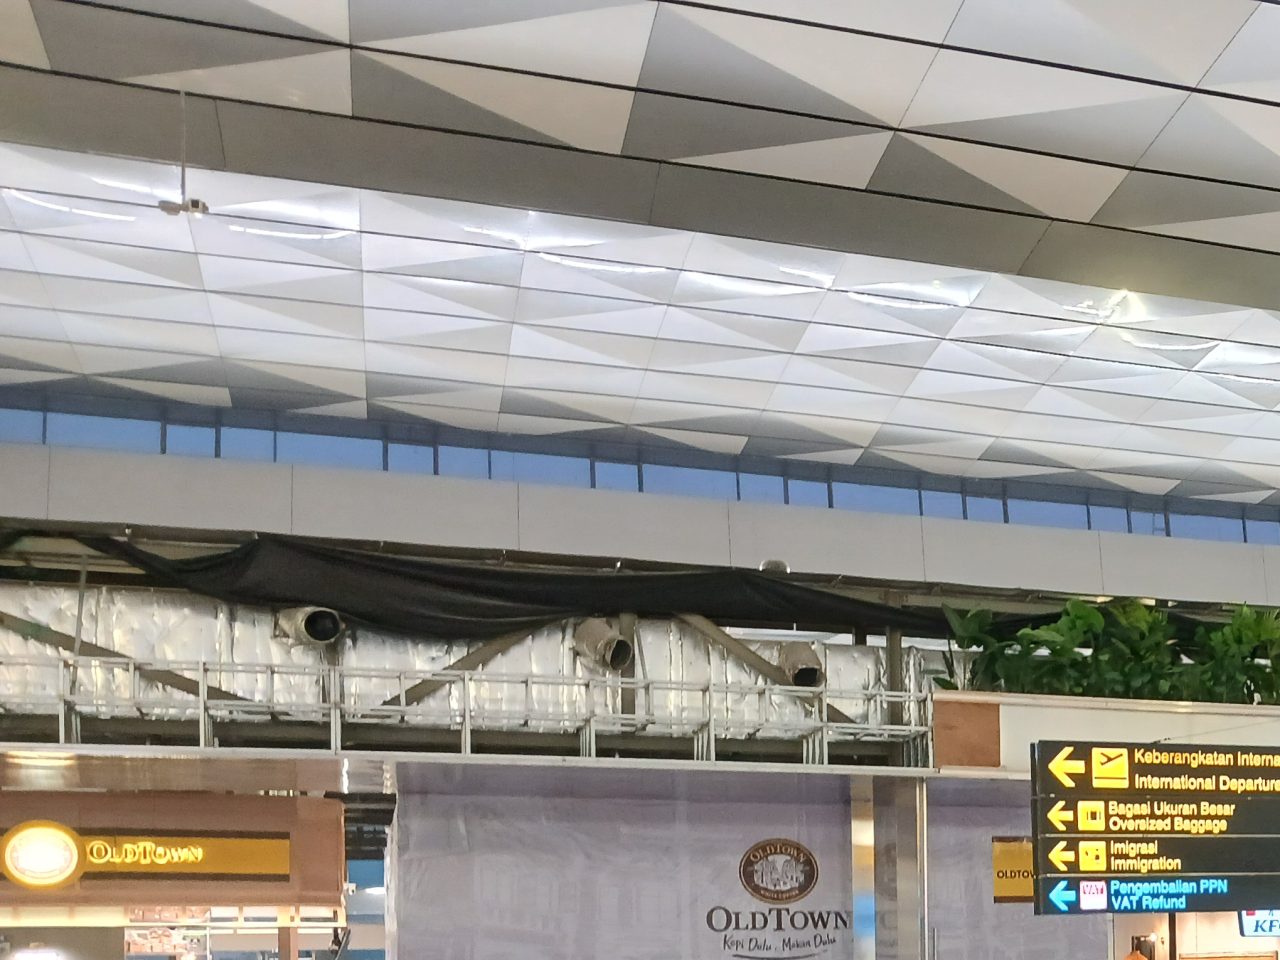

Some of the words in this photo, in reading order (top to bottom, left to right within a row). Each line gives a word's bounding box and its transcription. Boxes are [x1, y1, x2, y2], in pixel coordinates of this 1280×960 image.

[1134, 749, 1234, 768] Keberangkatan
[1135, 774, 1216, 790] International
[1109, 802, 1150, 817] Bagasi
[1155, 803, 1197, 816] Ukuran
[1201, 803, 1235, 816] Besar
[1109, 818, 1171, 831] Oversized
[1175, 819, 1227, 833] Baggage
[1111, 841, 1158, 855] Imigrasi
[1111, 856, 1181, 872] Immigration
[997, 869, 1035, 879] OLDTO
[1111, 880, 1196, 897] Pengembalian
[1200, 880, 1227, 894] PPN
[1112, 895, 1138, 910] VAT
[1143, 895, 1186, 909] Refund
[723, 934, 744, 951] Kopi
[814, 934, 837, 947] Dulu
